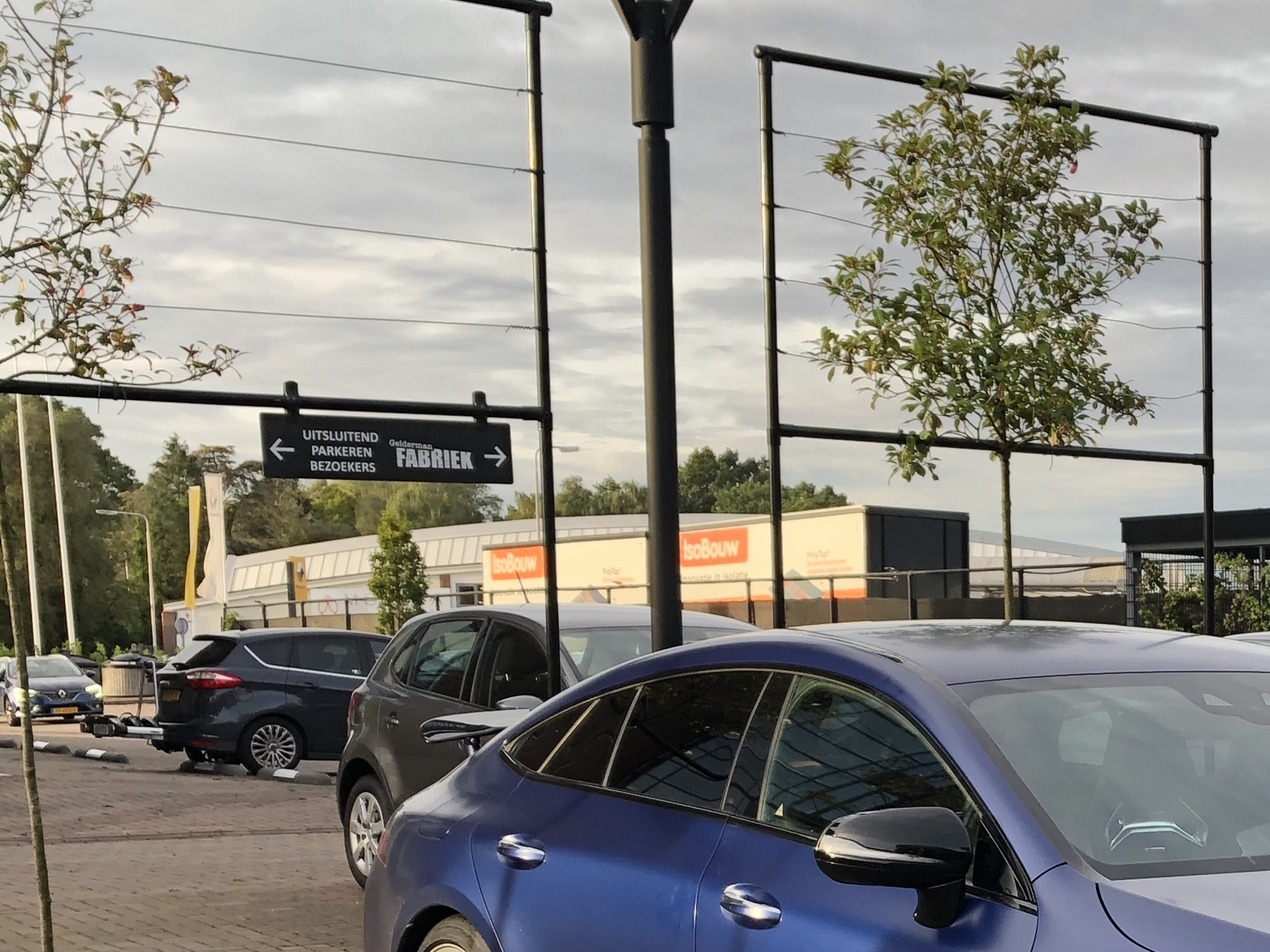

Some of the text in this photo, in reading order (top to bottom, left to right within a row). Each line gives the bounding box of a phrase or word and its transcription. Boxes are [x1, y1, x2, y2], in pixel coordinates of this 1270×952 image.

[302, 429, 379, 443] UITSLUITEND
[311, 444, 373, 458] PARKEREN
[388, 438, 433, 450] Gelderman
[395, 446, 474, 470] FABRIEK
[310, 460, 377, 473] BEZOEKERS
[683, 537, 740, 561] IsoBouw
[493, 552, 537, 574] IsoBouw
